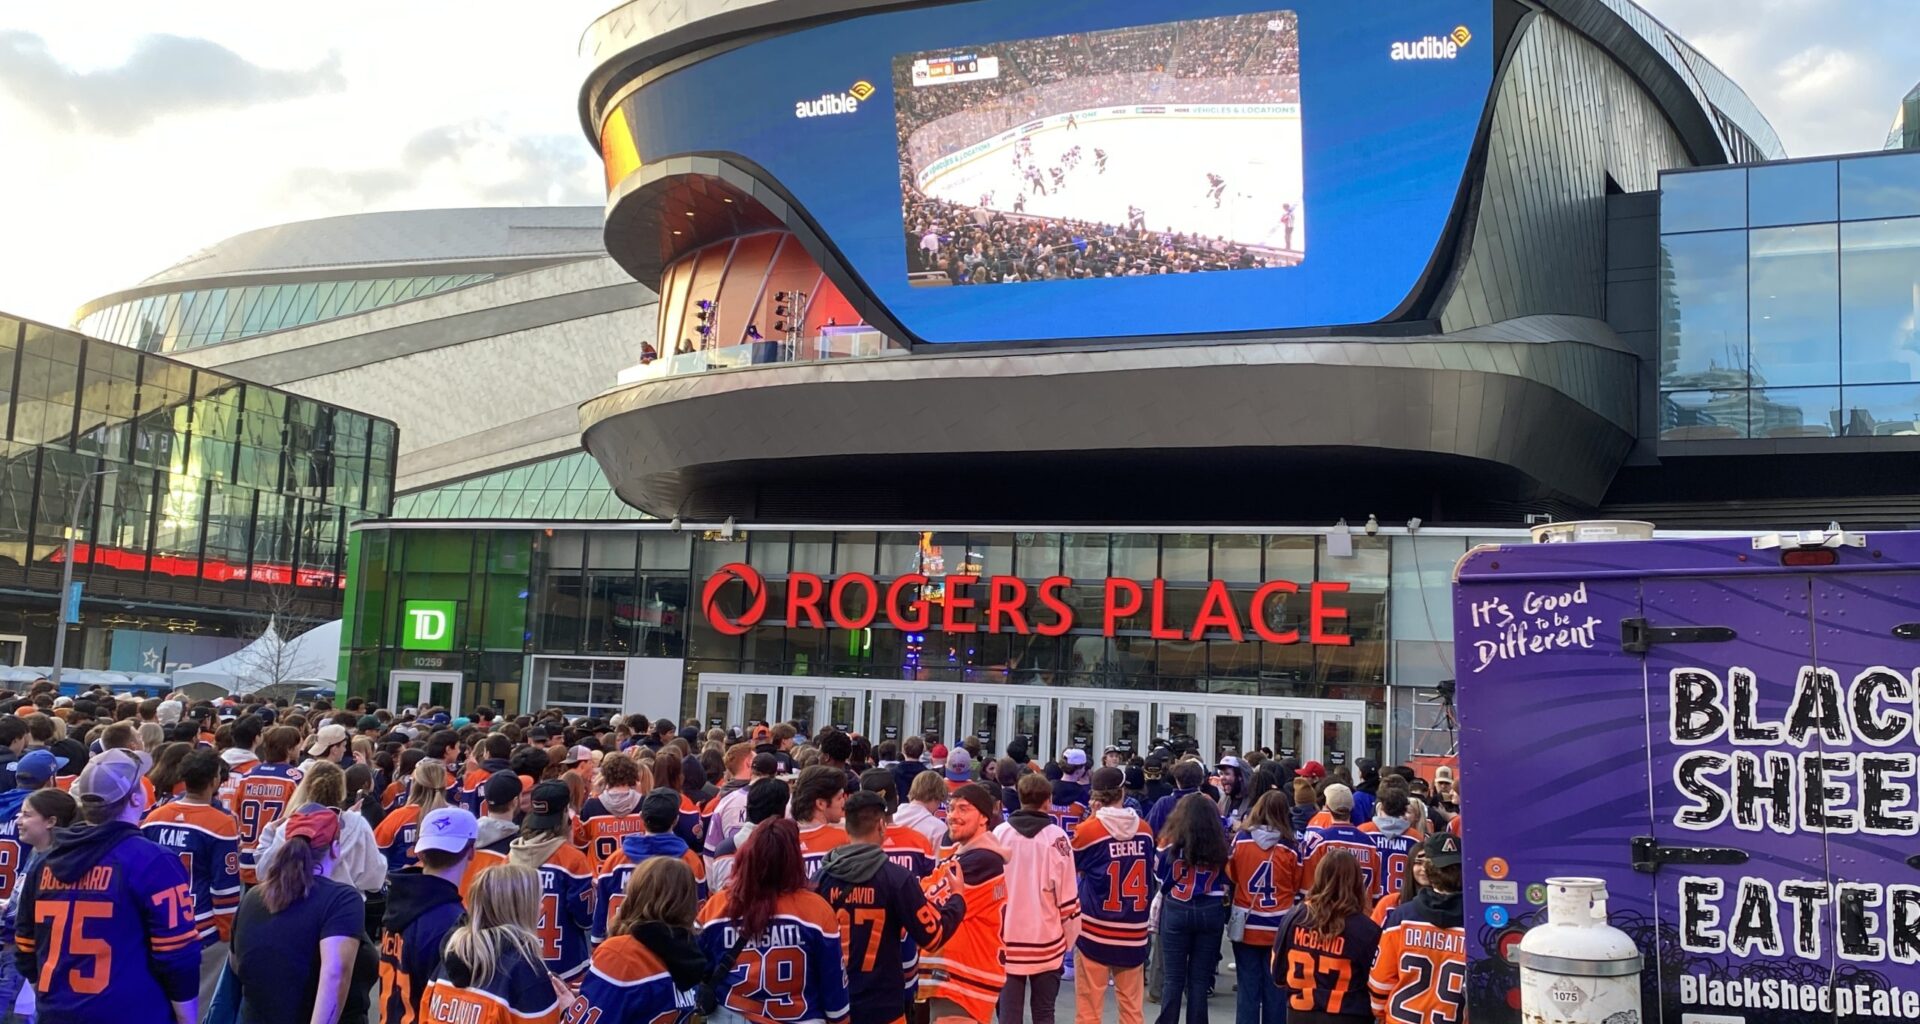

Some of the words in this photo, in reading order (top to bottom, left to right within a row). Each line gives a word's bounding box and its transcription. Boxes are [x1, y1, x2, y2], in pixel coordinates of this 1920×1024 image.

[1390, 36, 1457, 60] audible
[957, 64, 966, 72] LA
[795, 92, 857, 118] audible
[1242, 106, 1296, 114] LOCATIONS
[786, 572, 1074, 636] ROGERS
[1104, 577, 1352, 646] PLACE
[1471, 597, 1514, 628] It's
[1523, 581, 1588, 615] Good
[409, 609, 446, 640] TD
[1535, 617, 1550, 630] to
[1554, 612, 1570, 626] be
[1473, 616, 1602, 673] Different
[414, 657, 443, 667] 10259
[1669, 665, 1920, 748] BLAC
[245, 783, 285, 797] McDAVID
[1673, 749, 1920, 835] SHEE
[159, 829, 190, 848] KANE
[598, 820, 641, 833] McDAVID
[1109, 840, 1146, 858] EBERLE
[1377, 836, 1408, 850] HYMAN
[1103, 859, 1149, 912] 14
[1170, 859, 1220, 901] 97
[1248, 860, 1278, 908] 4
[152, 883, 195, 929] 75
[830, 887, 875, 905] MAVID
[35, 901, 113, 994] 75
[725, 945, 808, 1020] 29
[1286, 950, 1352, 1014] 97
[1388, 952, 1466, 1024] 29
[1554, 992, 1578, 1002] 1075
